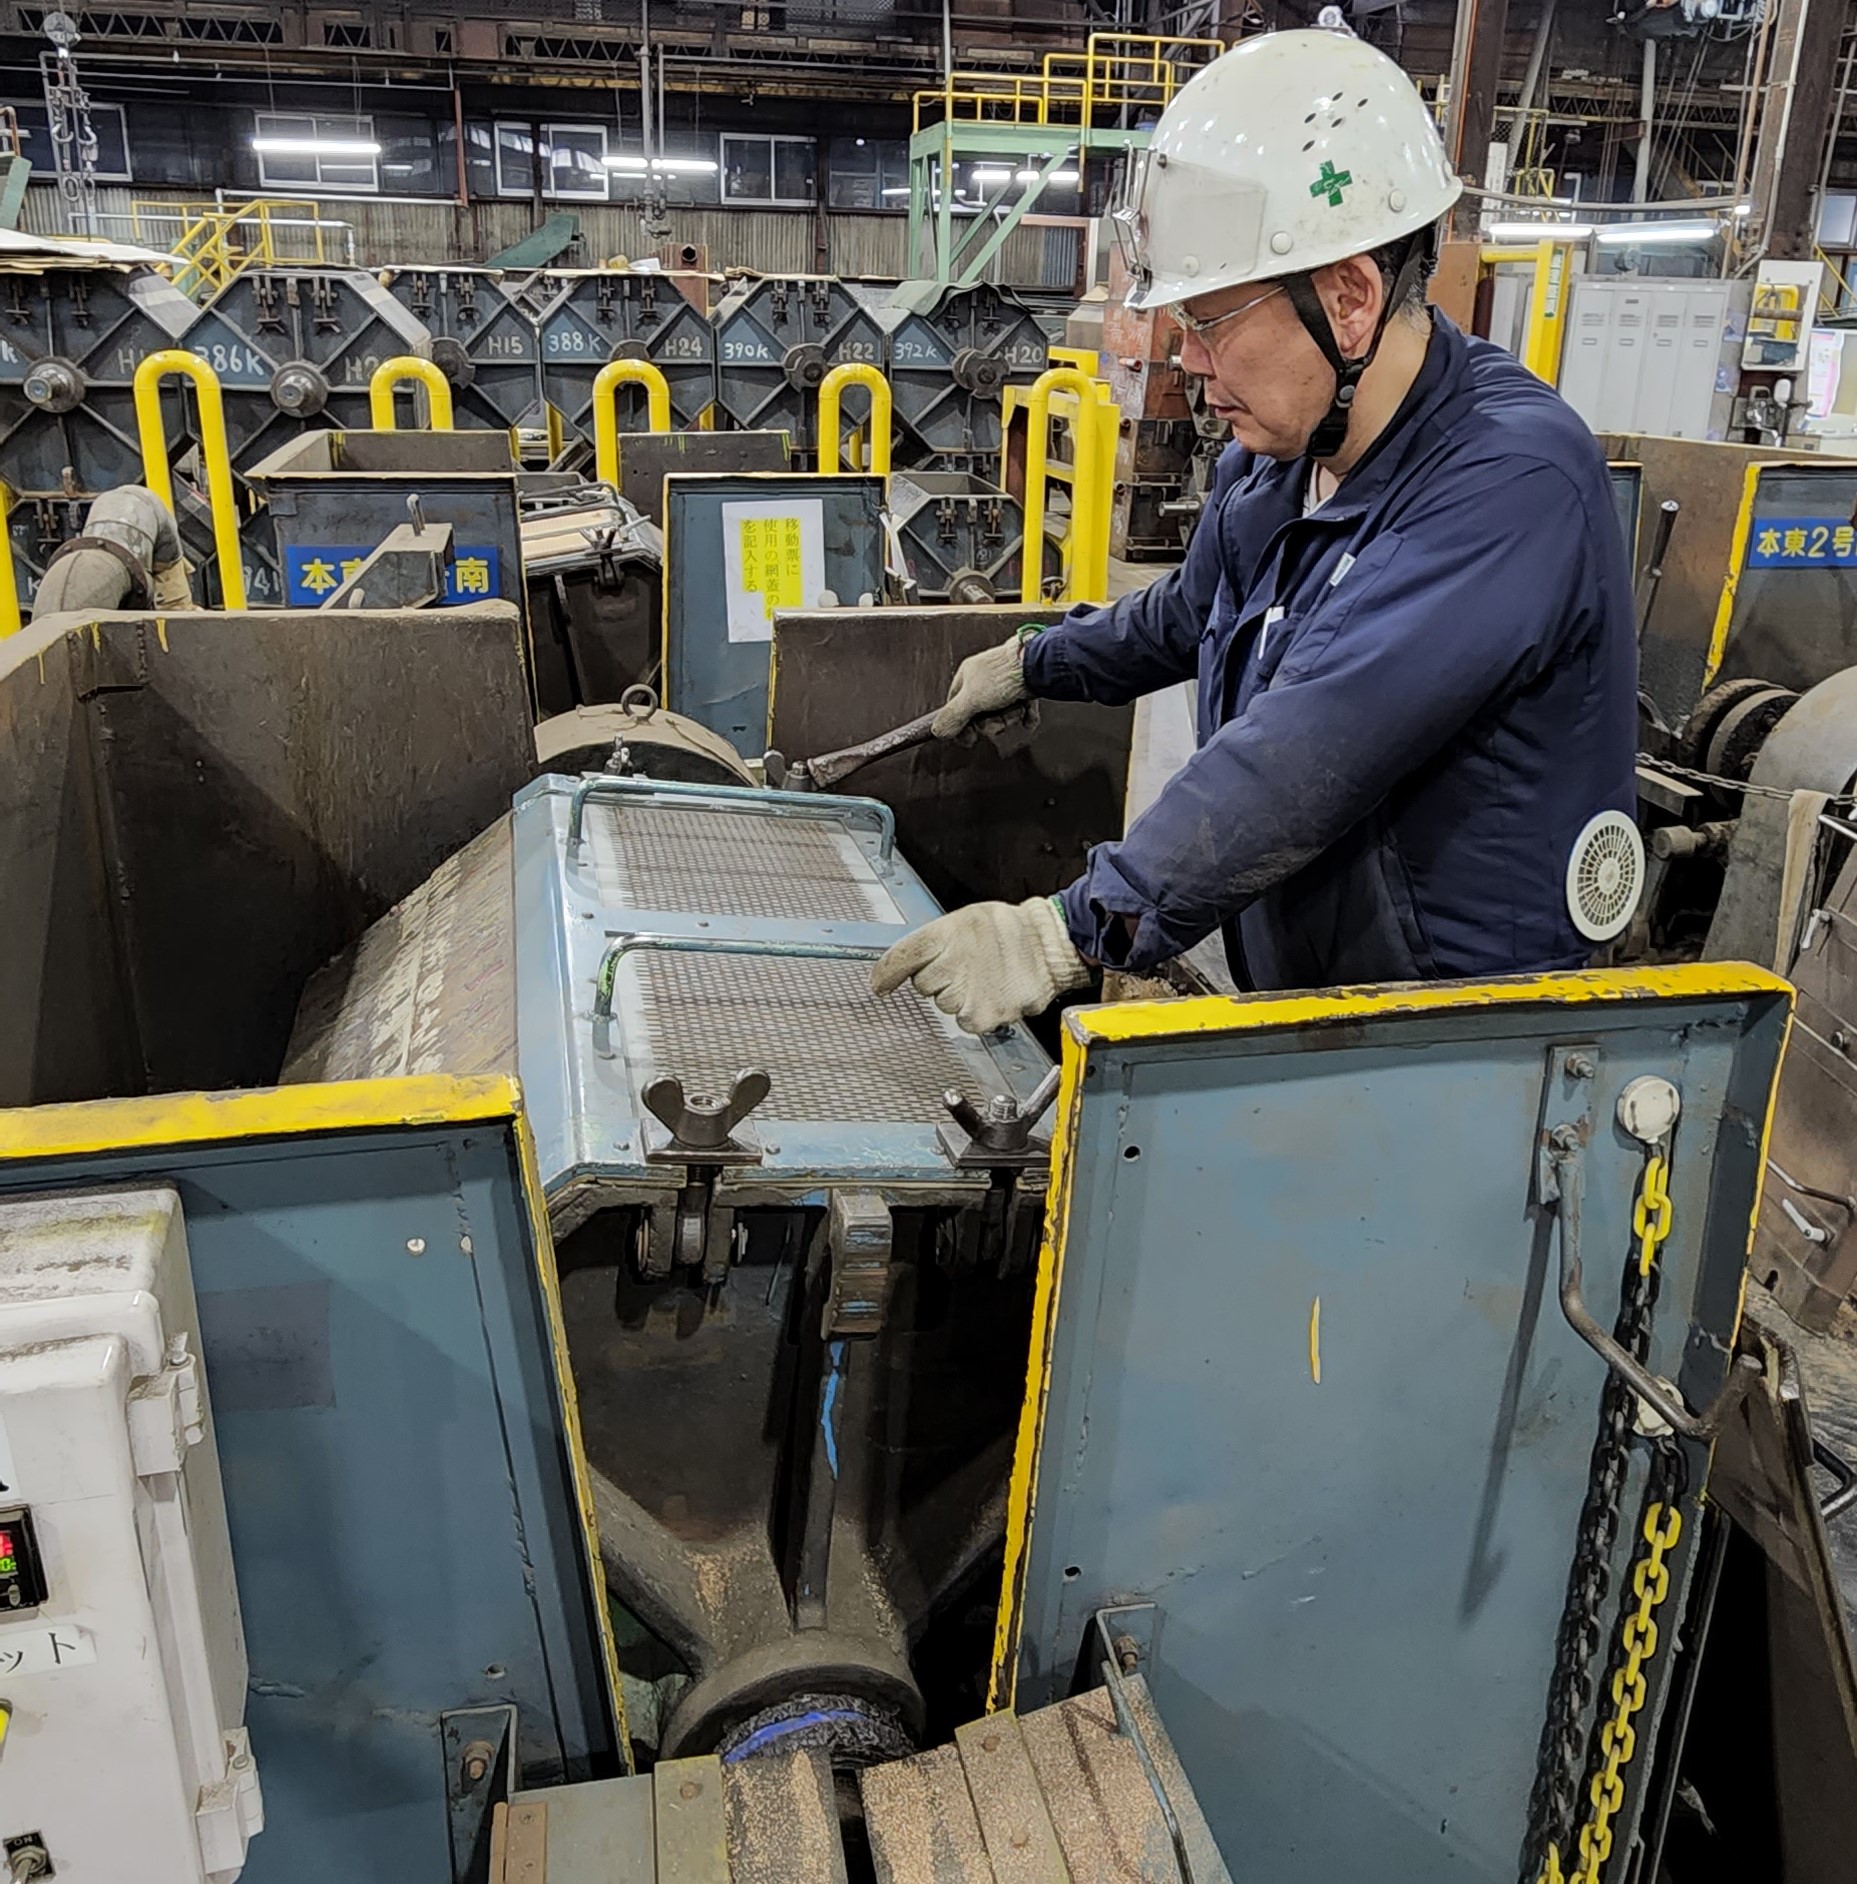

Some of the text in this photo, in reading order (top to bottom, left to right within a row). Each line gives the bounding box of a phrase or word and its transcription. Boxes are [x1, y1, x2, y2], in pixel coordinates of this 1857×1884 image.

[487, 335, 524, 356] H15
[664, 336, 704, 358] H24
[838, 341, 875, 361] H22
[1004, 345, 1043, 364] H20
[1756, 526, 1857, 558] 本東2号
[743, 519, 758, 593] を記入する
[13, 1835, 33, 1847] ON
